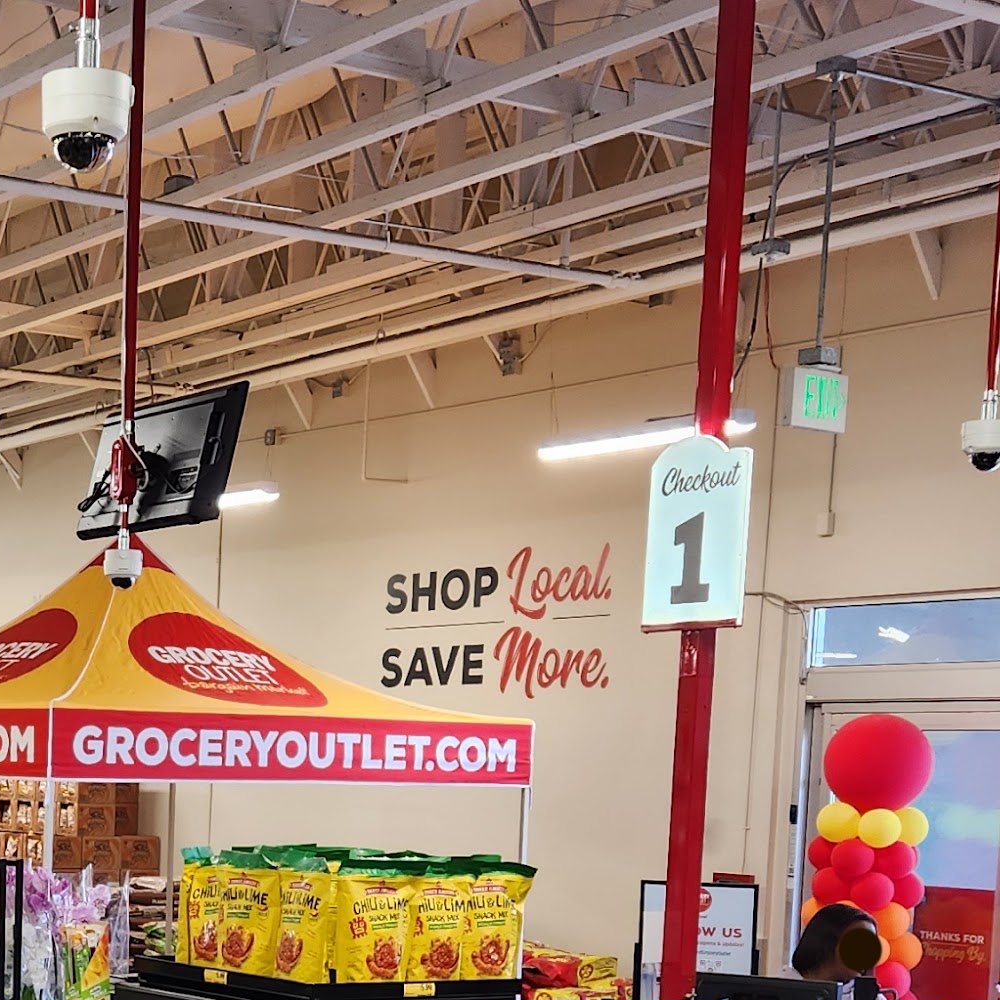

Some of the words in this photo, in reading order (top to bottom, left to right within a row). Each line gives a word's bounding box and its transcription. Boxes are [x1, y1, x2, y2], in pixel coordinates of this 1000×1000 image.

[803, 374, 840, 419] EXIT
[661, 461, 742, 497] Checkout
[670, 511, 710, 605] 1
[385, 566, 499, 614] SHOP
[506, 542, 612, 620] Local.
[147, 645, 278, 673] GROCERY
[183, 663, 280, 685] OUTLET
[380, 643, 485, 688] SAVE
[493, 626, 610, 699] More.
[181, 679, 253, 694] bargain
[73, 725, 517, 773] GROCERYOUTLET.COM
[722, 927, 743, 938] US
[919, 930, 961, 943] THANKS
[963, 934, 985, 945] FOR
